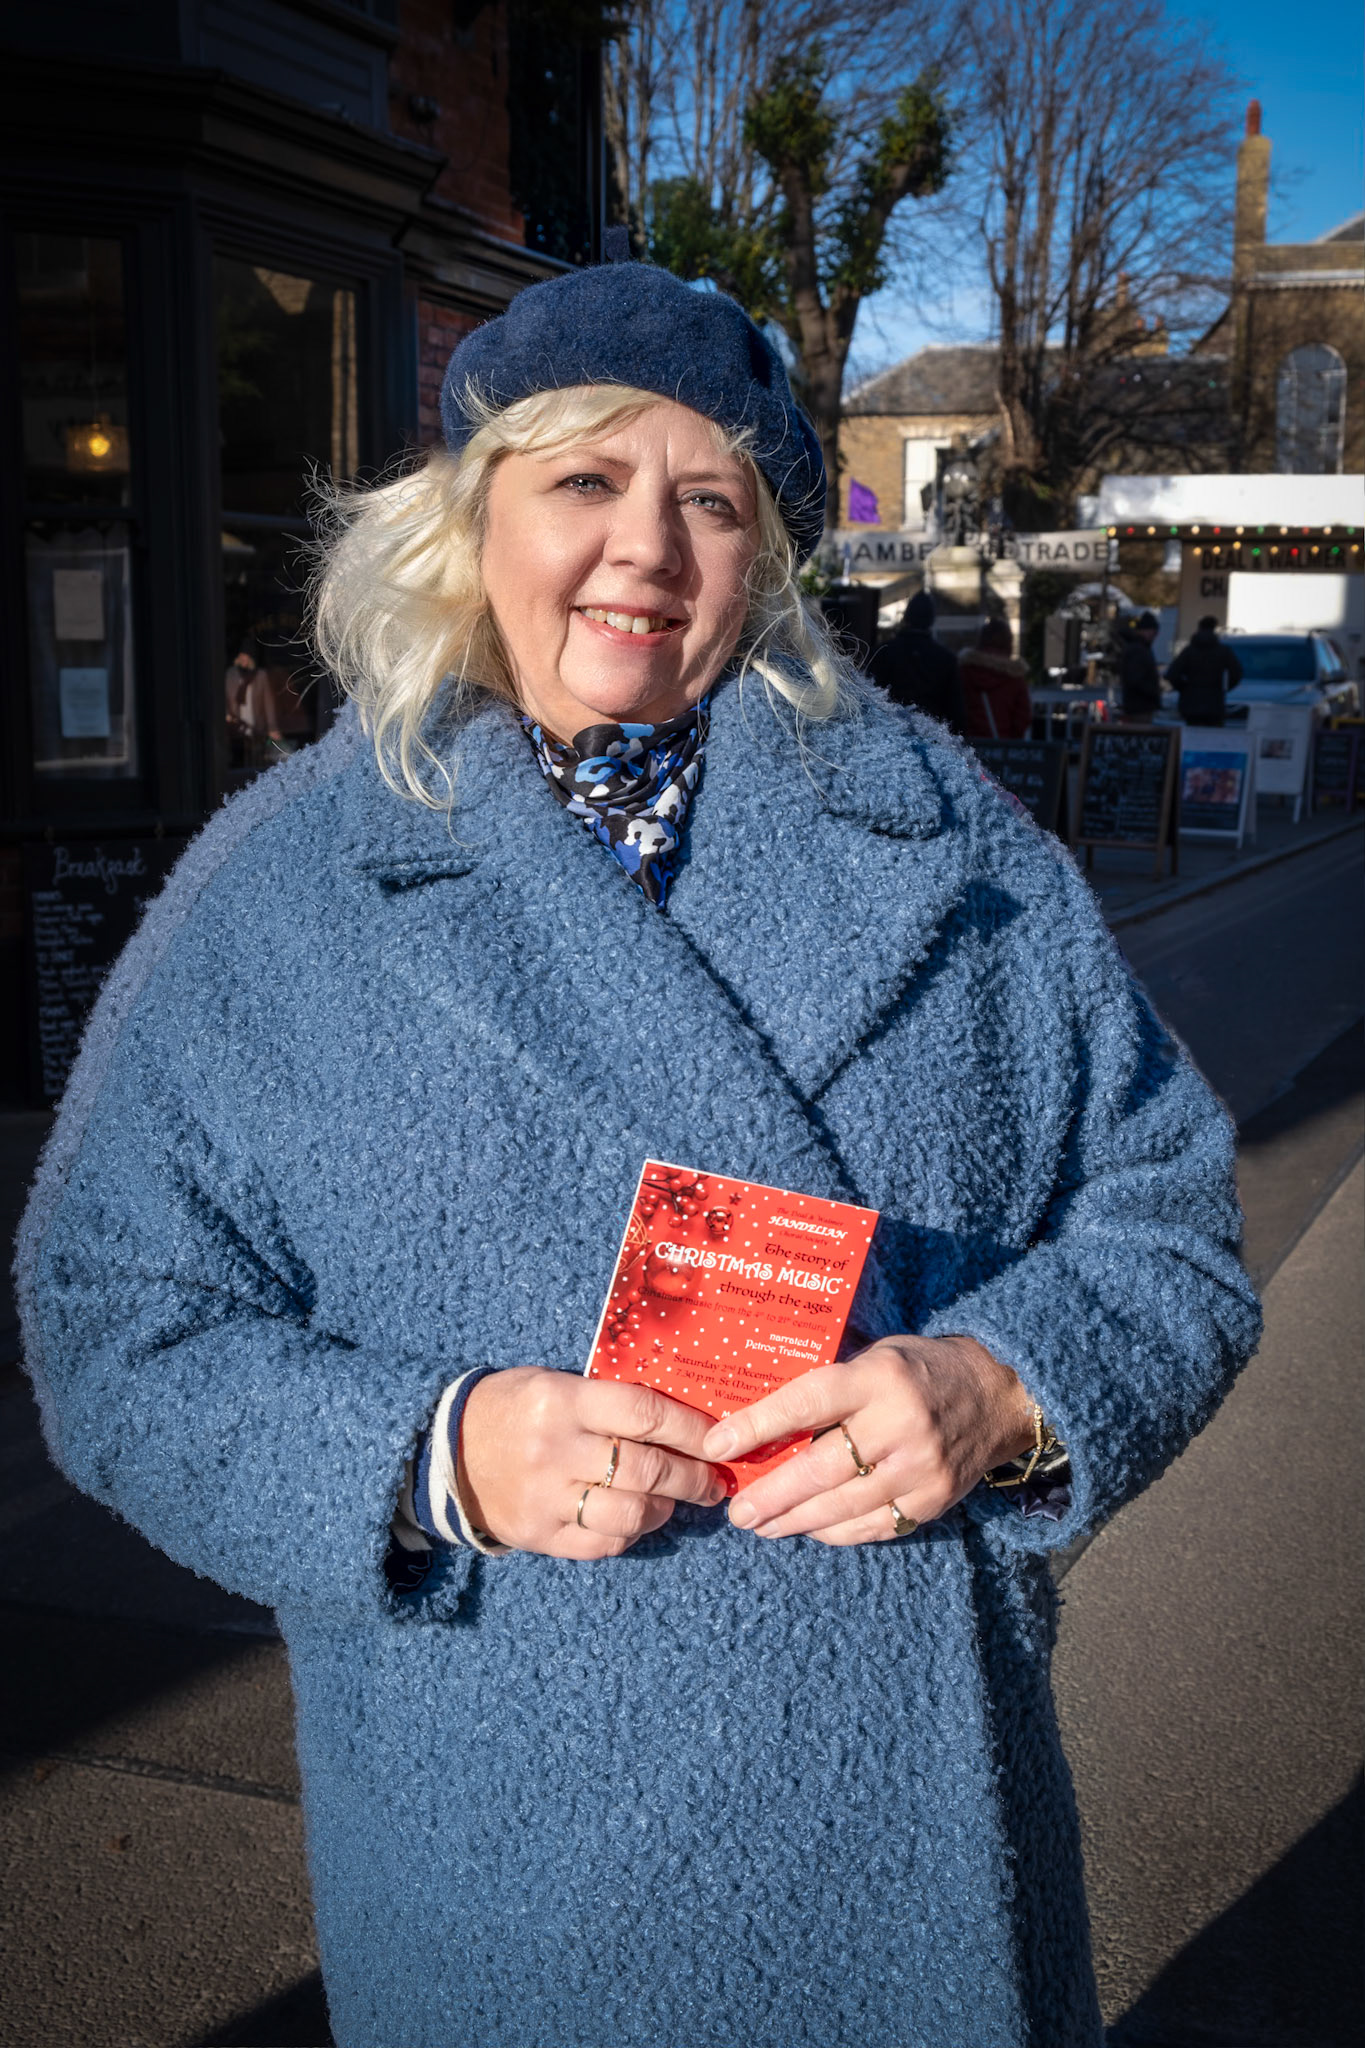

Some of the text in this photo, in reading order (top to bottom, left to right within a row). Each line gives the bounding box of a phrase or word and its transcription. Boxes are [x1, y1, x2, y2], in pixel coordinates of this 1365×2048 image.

[1024, 542, 1107, 561] TRADE
[1202, 549, 1245, 570] DEAL
[52, 846, 146, 894] Breakfast
[768, 1216, 848, 1239] HANDELIAN
[655, 1241, 844, 1294] CHRISTMAS MUSIC
[765, 1243, 850, 1271] The story of
[720, 1281, 833, 1315] through the ages
[685, 1297, 712, 1310] music
[713, 1302, 736, 1313] from
[766, 1313, 776, 1322] to
[792, 1318, 827, 1333] century
[769, 1333, 823, 1351] narrated by
[779, 1345, 819, 1363] Trelawny
[673, 1353, 720, 1373] Saturday
[737, 1366, 785, 1383] December
[718, 1376, 730, 1387] St
